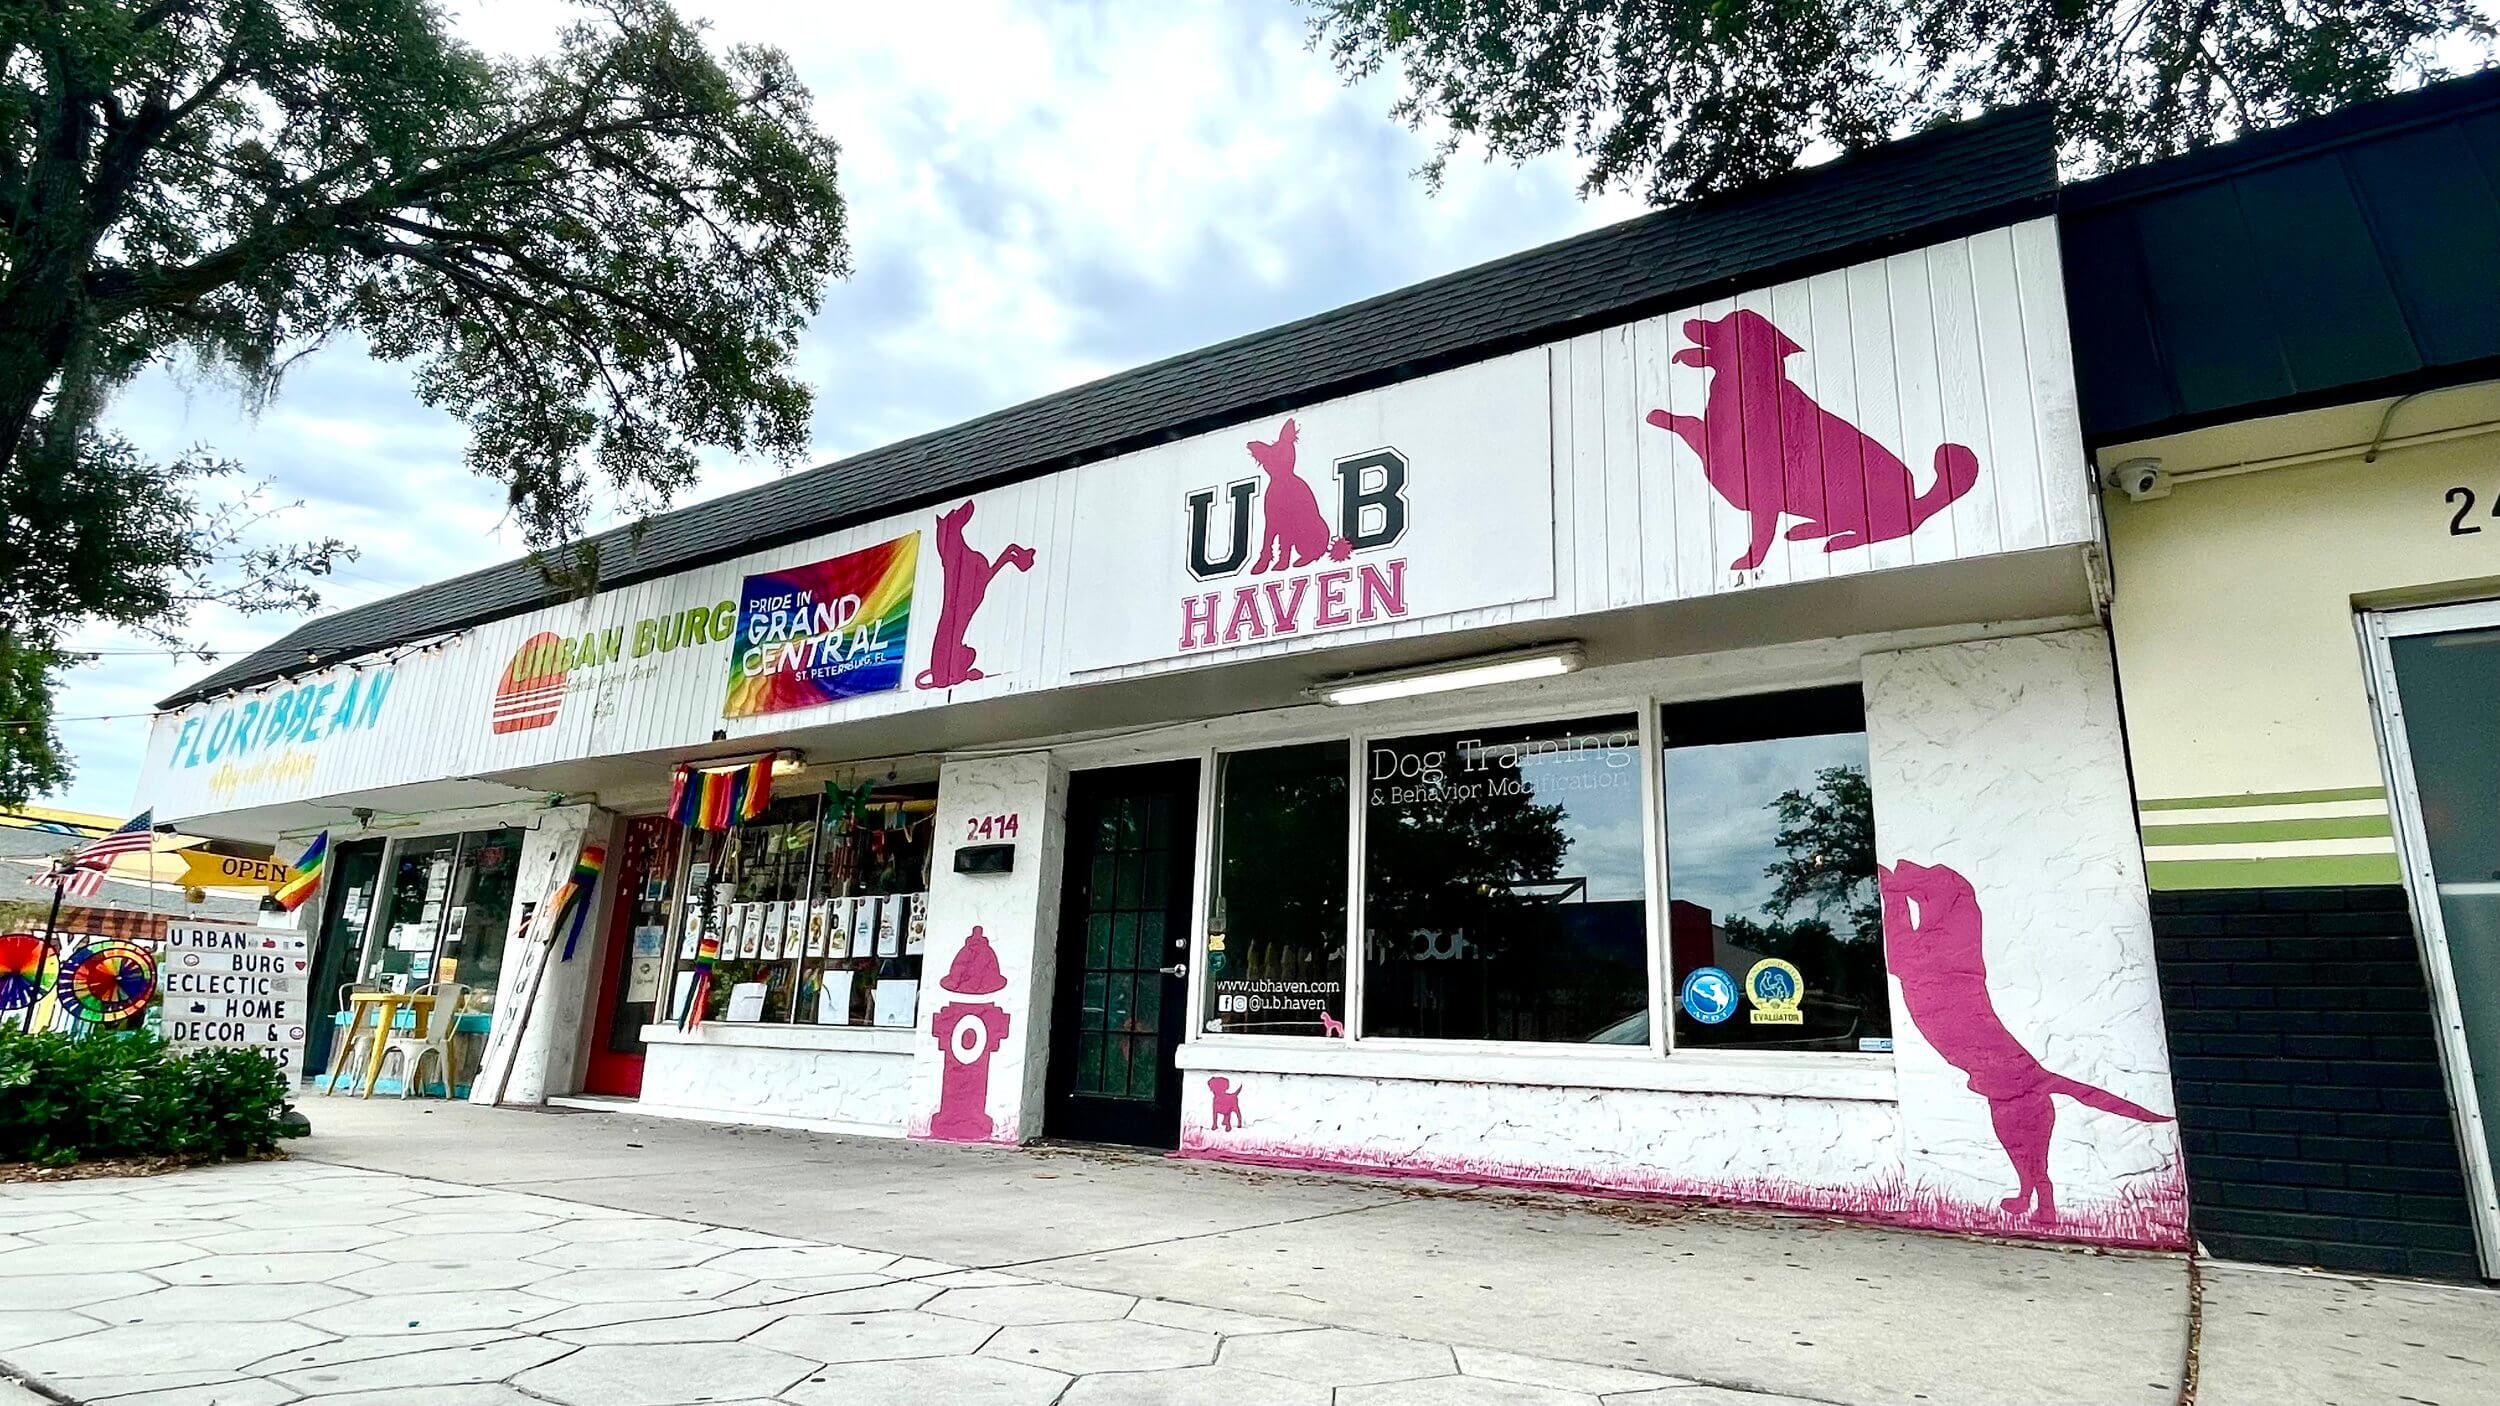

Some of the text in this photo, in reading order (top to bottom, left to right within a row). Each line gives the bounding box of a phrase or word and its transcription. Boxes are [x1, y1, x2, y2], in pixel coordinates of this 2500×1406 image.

[2445, 486, 2500, 536] 2
[749, 589, 812, 614] PRIDE IN
[1179, 557, 1408, 651] HAVEN
[748, 593, 861, 645] GRAND
[513, 600, 737, 682] URBAN BURG
[742, 618, 889, 678] CENTRAL
[794, 670, 809, 682] ST.
[874, 653, 887, 663] FL
[169, 666, 396, 769] FLORIBBEAN
[1372, 731, 1633, 783] Dog Training
[1371, 770, 1630, 806] & Behavior Modification
[967, 813, 1019, 840] 2414
[222, 858, 288, 883] OPEN
[171, 929, 247, 949] URBAN
[232, 954, 285, 974] BURG
[167, 974, 270, 995] ECLECTIC
[1216, 979, 1340, 993] www.ubhaven.com
[226, 998, 286, 1019] HOME
[1249, 994, 1326, 1012] @u.b.haven
[1753, 1013, 1800, 1022] EVALUATOR
[174, 1022, 279, 1042] DECOR &
